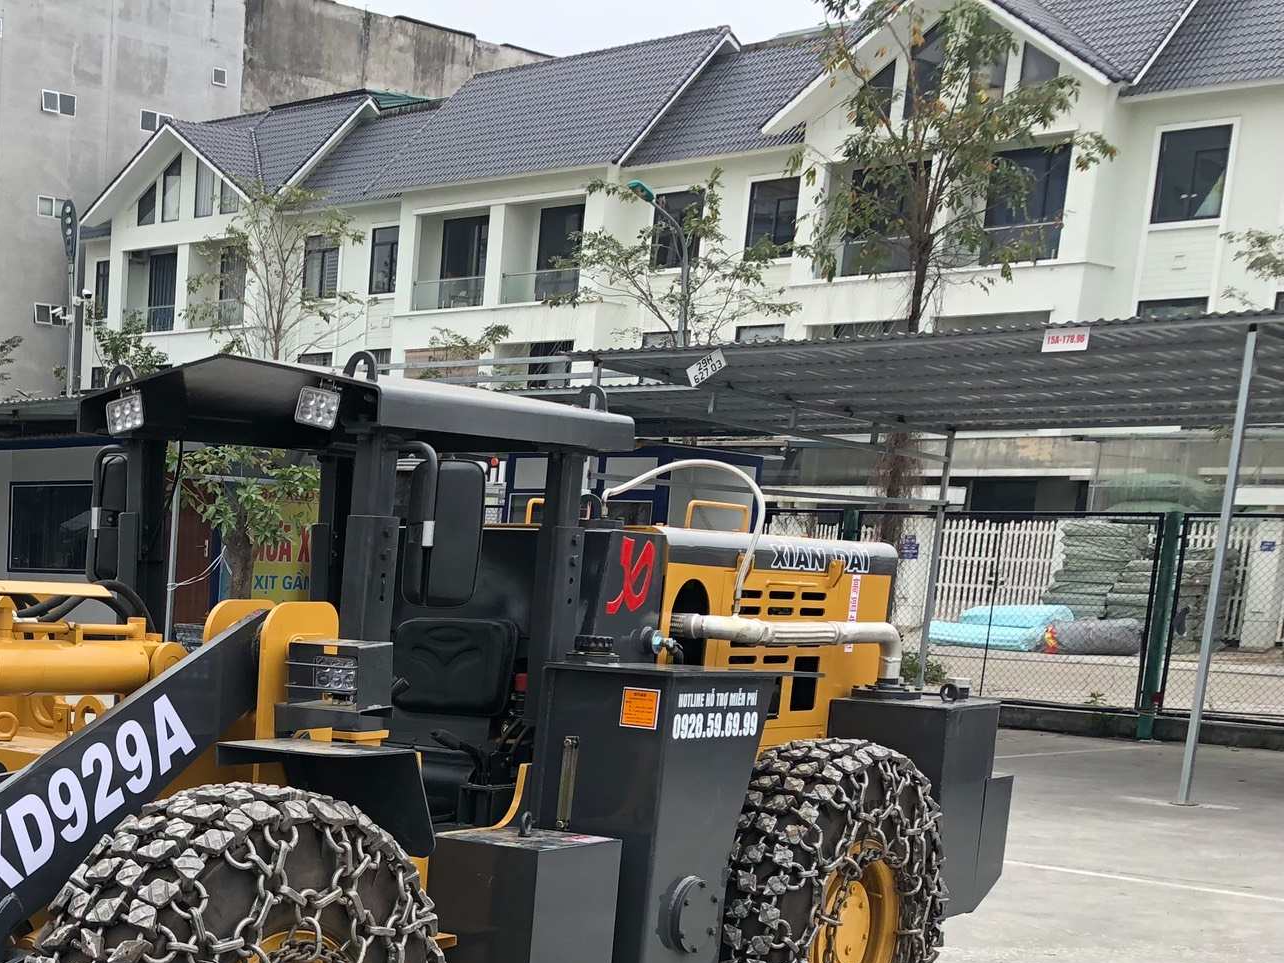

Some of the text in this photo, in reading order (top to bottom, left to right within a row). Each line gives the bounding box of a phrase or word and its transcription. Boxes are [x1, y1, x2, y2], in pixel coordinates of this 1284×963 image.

[254, 575, 278, 594] XỊT
[678, 693, 705, 707] HOTLINE
[716, 692, 729, 709] TRỢ
[746, 690, 758, 706] PHÍ
[672, 711, 758, 739] 0928.59.69.99
